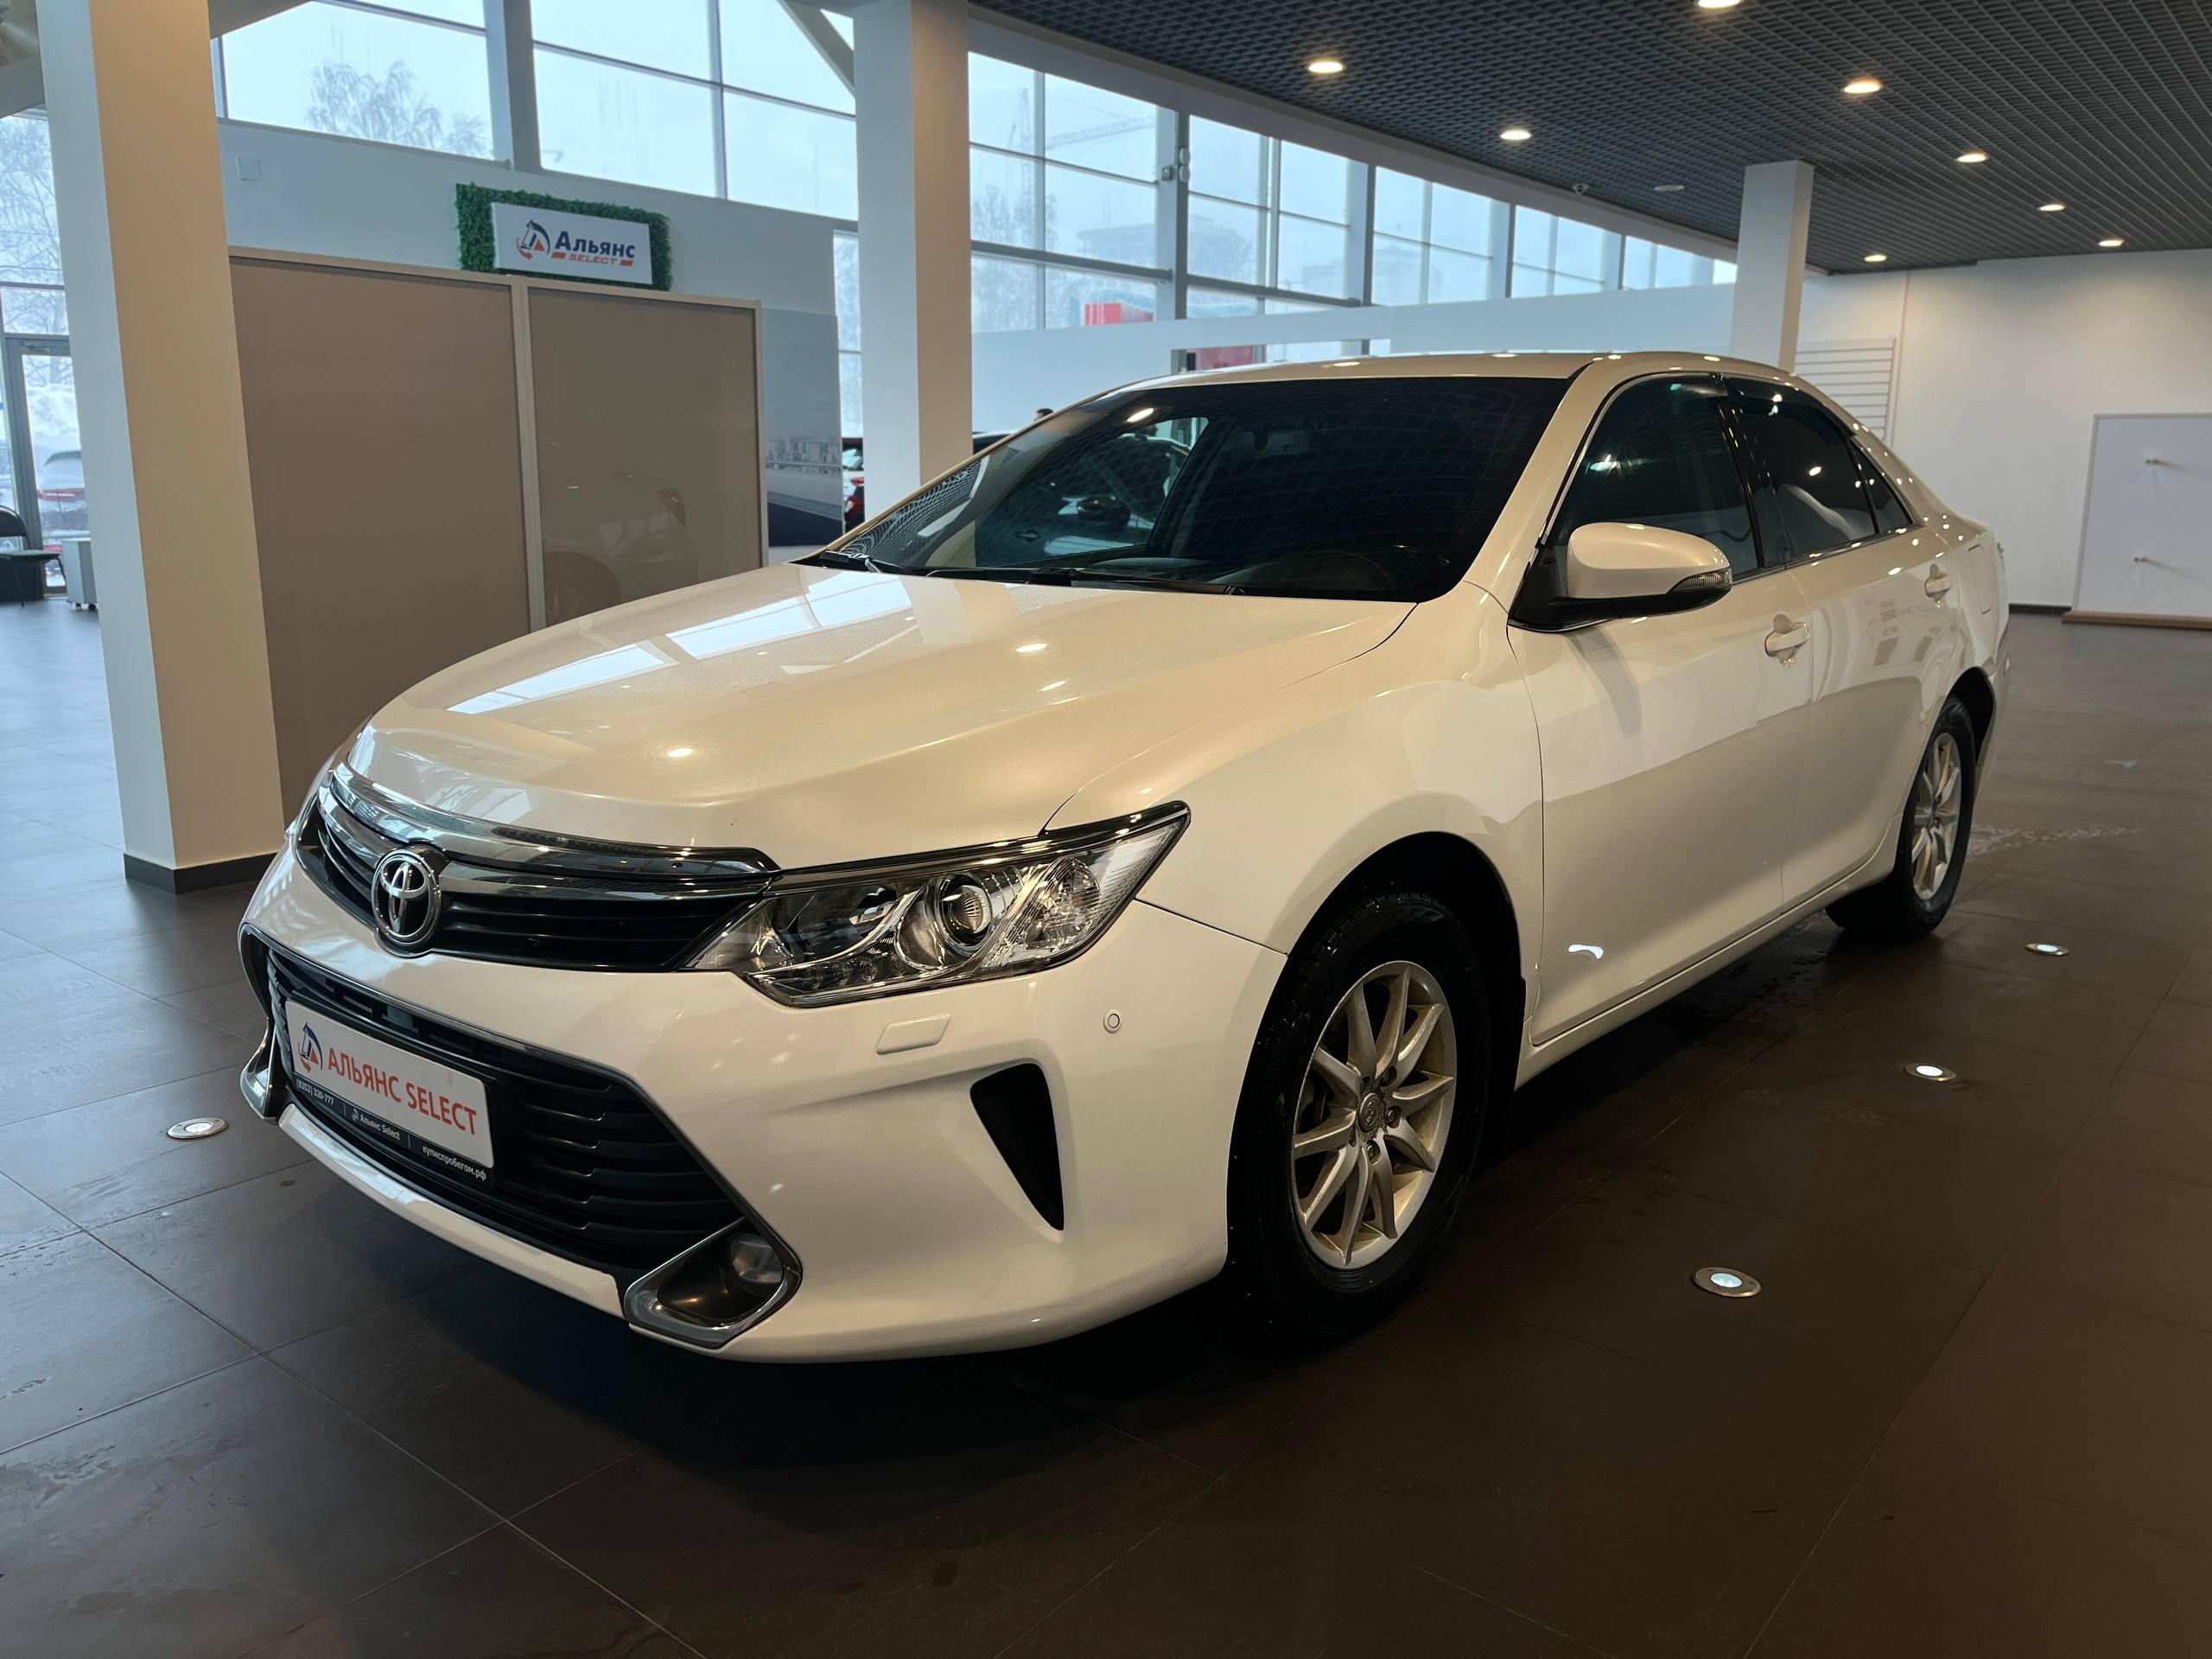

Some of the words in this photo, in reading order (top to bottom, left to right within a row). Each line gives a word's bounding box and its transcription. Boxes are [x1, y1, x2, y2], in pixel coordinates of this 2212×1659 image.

[554, 231, 636, 258] Альянс
[569, 253, 619, 265] SELECT
[327, 1047, 401, 1103] АЛЬЯНС
[405, 1082, 477, 1135] SELECT
[360, 1114, 381, 1131] Альянс
[381, 1124, 401, 1141] Select
[422, 1145, 487, 1182] куписпробегом.рф
